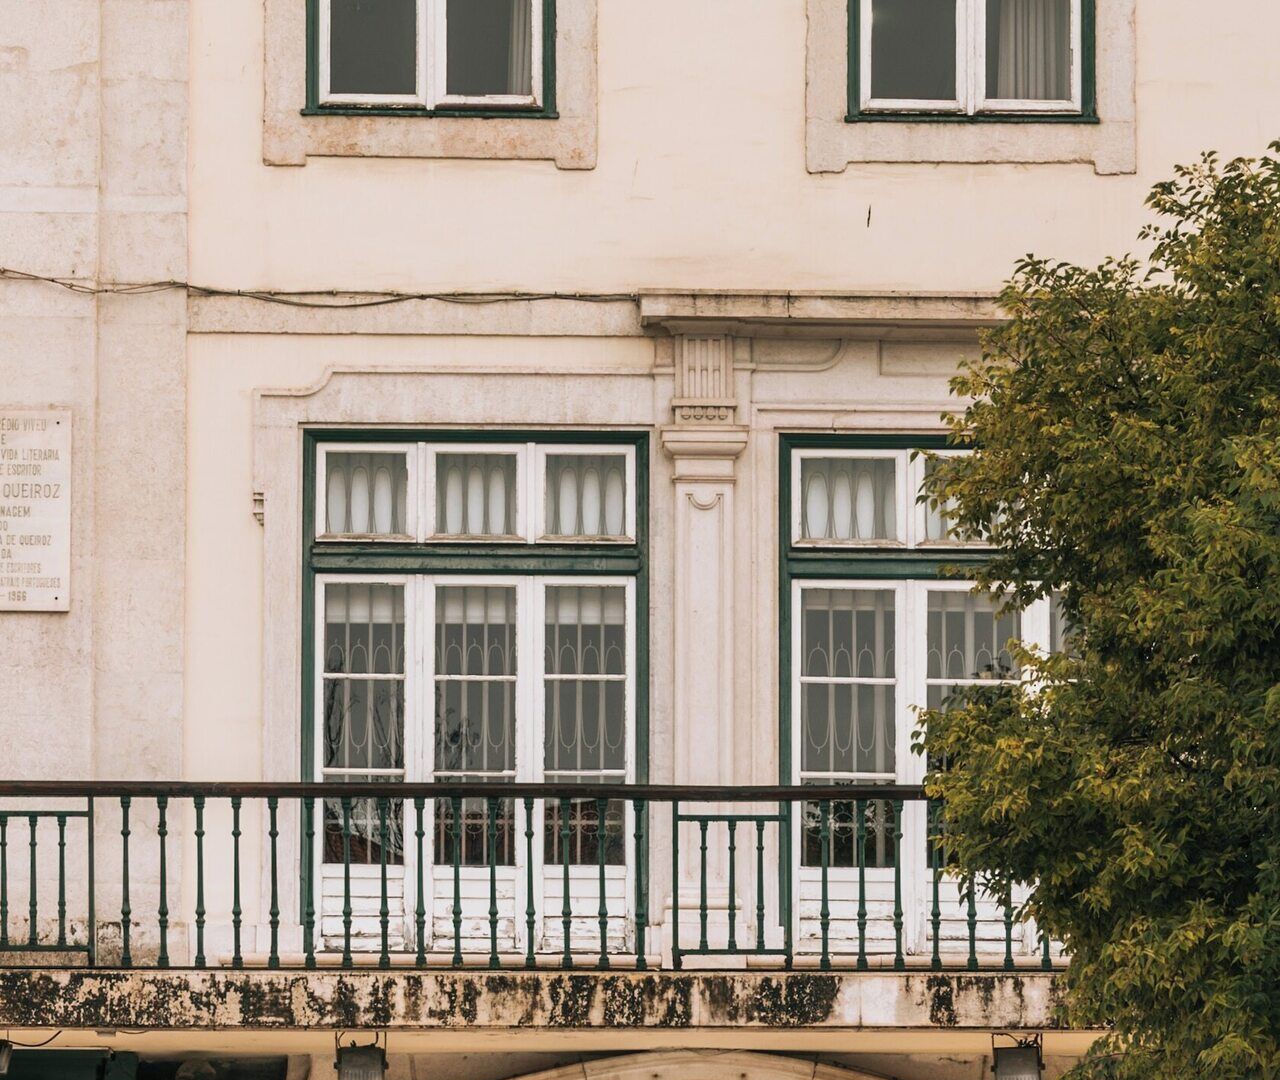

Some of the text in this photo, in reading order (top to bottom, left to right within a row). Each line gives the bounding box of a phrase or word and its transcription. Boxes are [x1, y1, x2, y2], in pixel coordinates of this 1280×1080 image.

[23, 418, 47, 432] VIVEU
[0, 433, 7, 445] E
[1, 448, 18, 461] VIDA
[7, 463, 42, 477] ESCRITOR
[2, 483, 61, 499] QUEIROZ
[6, 534, 17, 546] DE
[19, 534, 52, 547] QUEIROZ
[1, 548, 12, 559] DA
